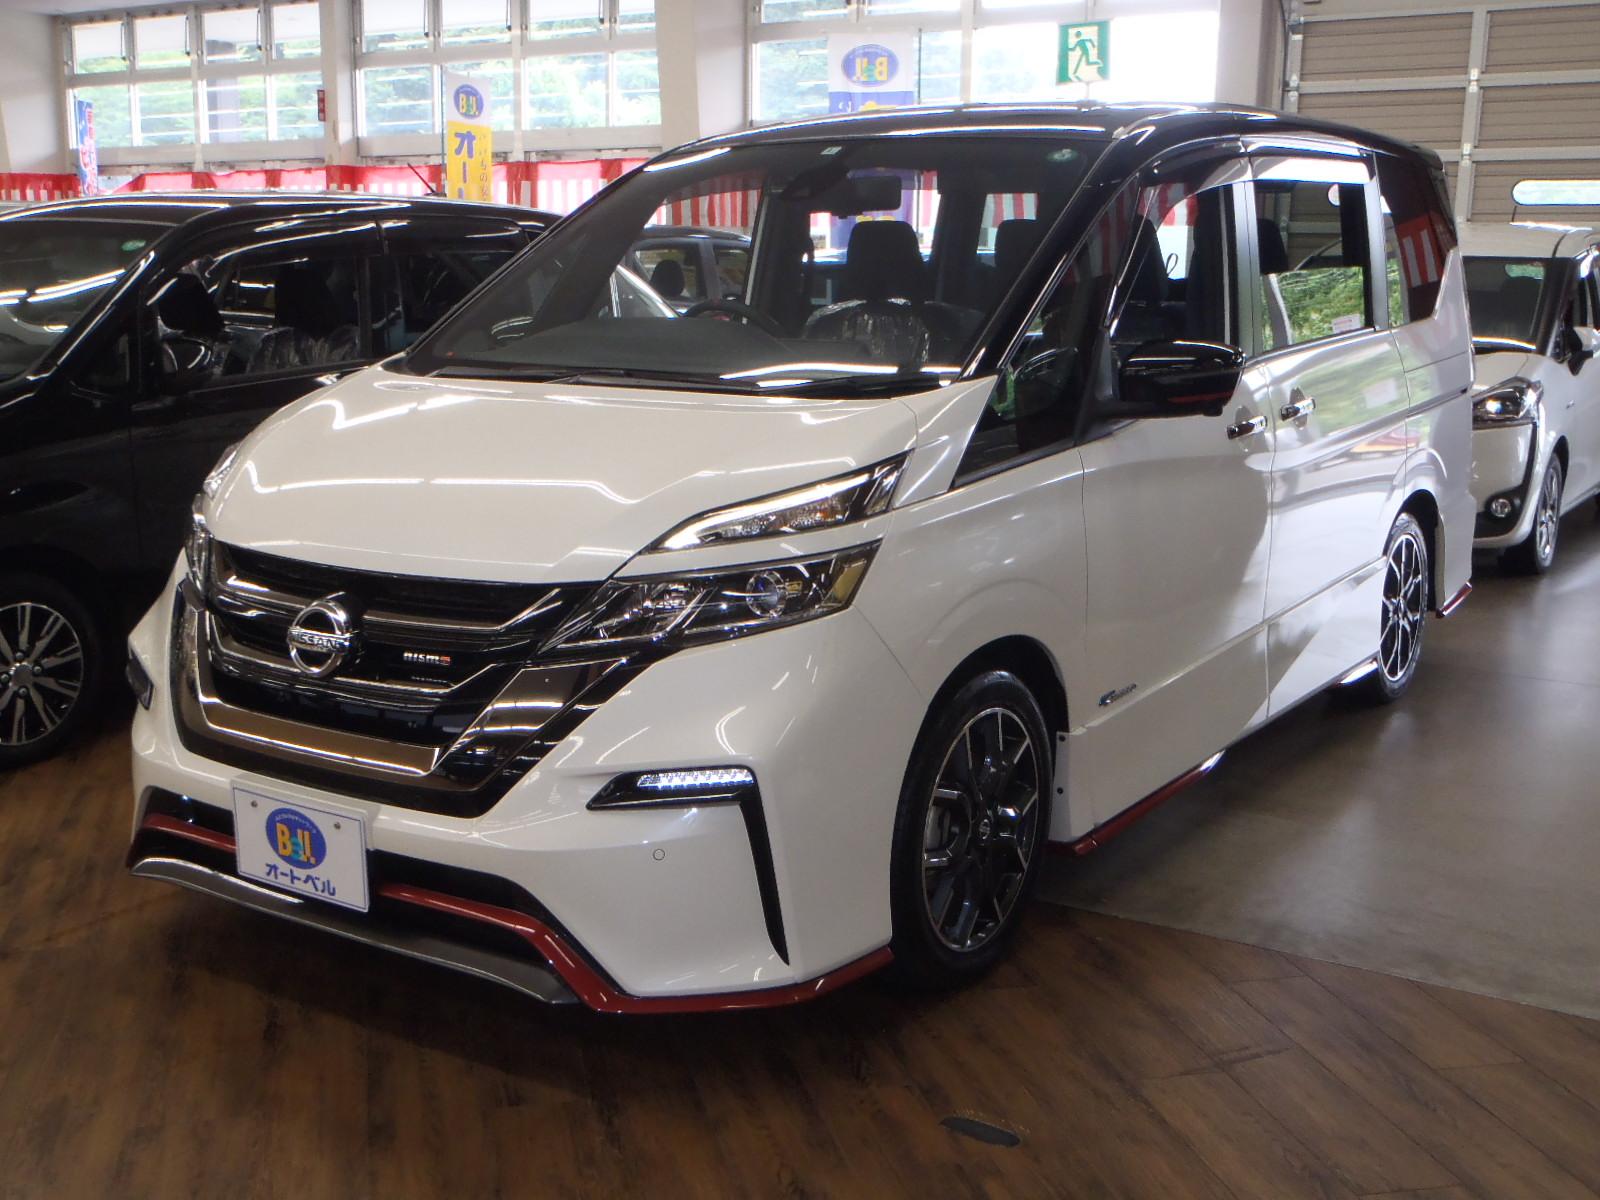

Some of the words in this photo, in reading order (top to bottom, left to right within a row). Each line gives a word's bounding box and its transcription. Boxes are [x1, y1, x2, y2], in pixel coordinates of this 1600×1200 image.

[290, 631, 337, 650] NISSAN
[265, 863, 337, 897] オートベル
